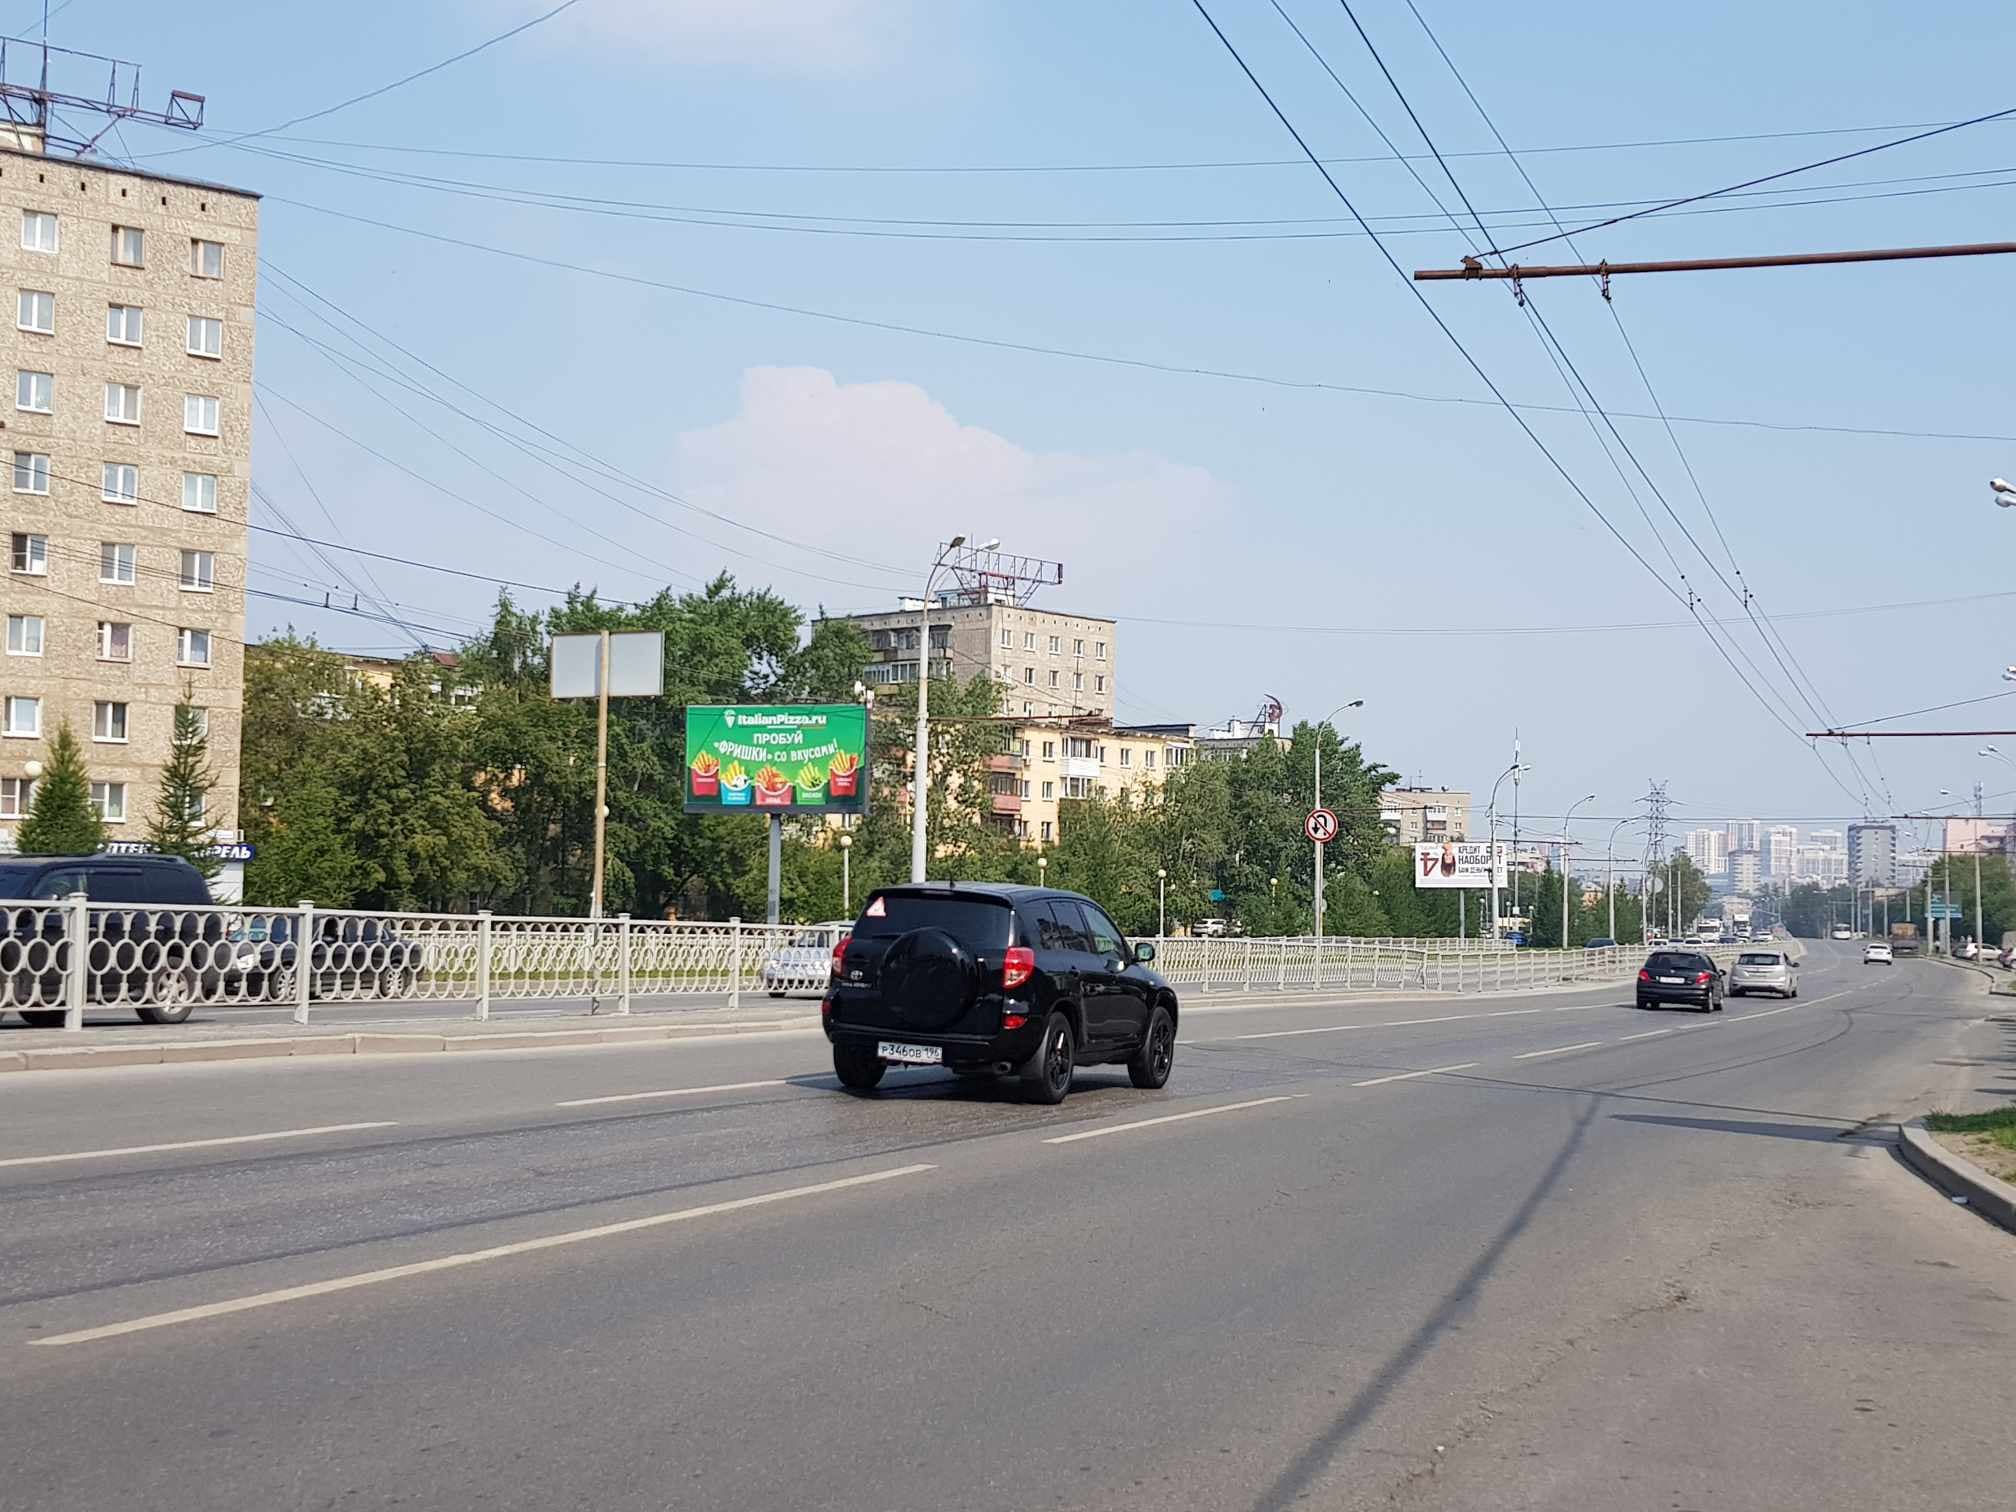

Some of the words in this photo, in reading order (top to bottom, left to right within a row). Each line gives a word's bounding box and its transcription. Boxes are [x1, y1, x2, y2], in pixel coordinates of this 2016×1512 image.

[738, 713, 827, 725] ItalianPizza.ru
[753, 730, 803, 745] ПРОБУЙ
[1458, 855, 1502, 864] НАОБОРТ
